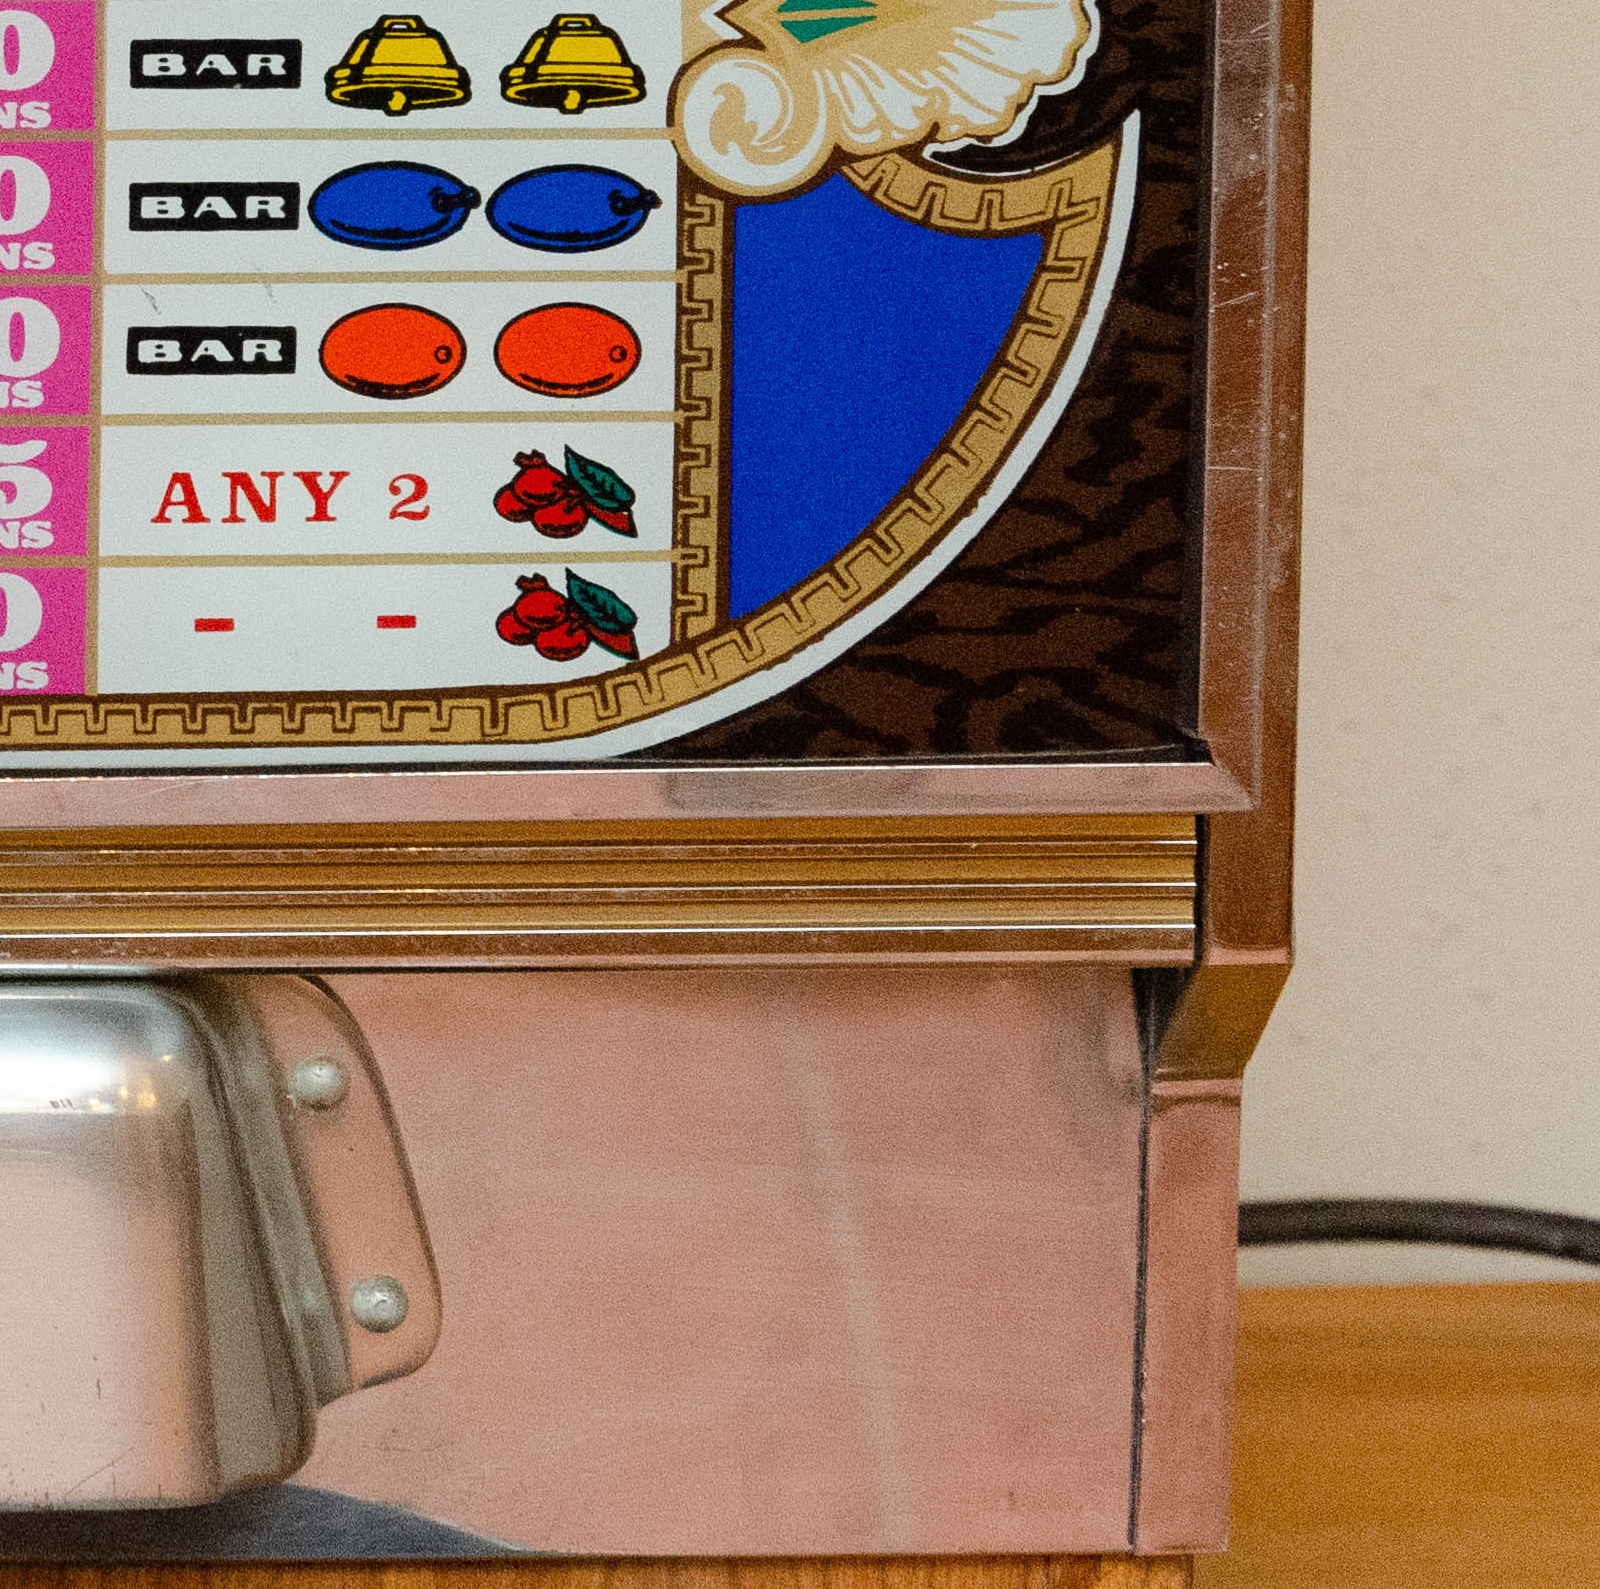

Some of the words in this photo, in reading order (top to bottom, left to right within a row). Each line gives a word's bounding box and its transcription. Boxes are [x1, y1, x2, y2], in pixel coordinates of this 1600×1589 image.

[141, 52, 287, 78] BAR
[139, 194, 286, 220] BAR
[136, 338, 283, 365] BAR
[150, 470, 350, 525] ANY
[387, 472, 432, 523] 2
